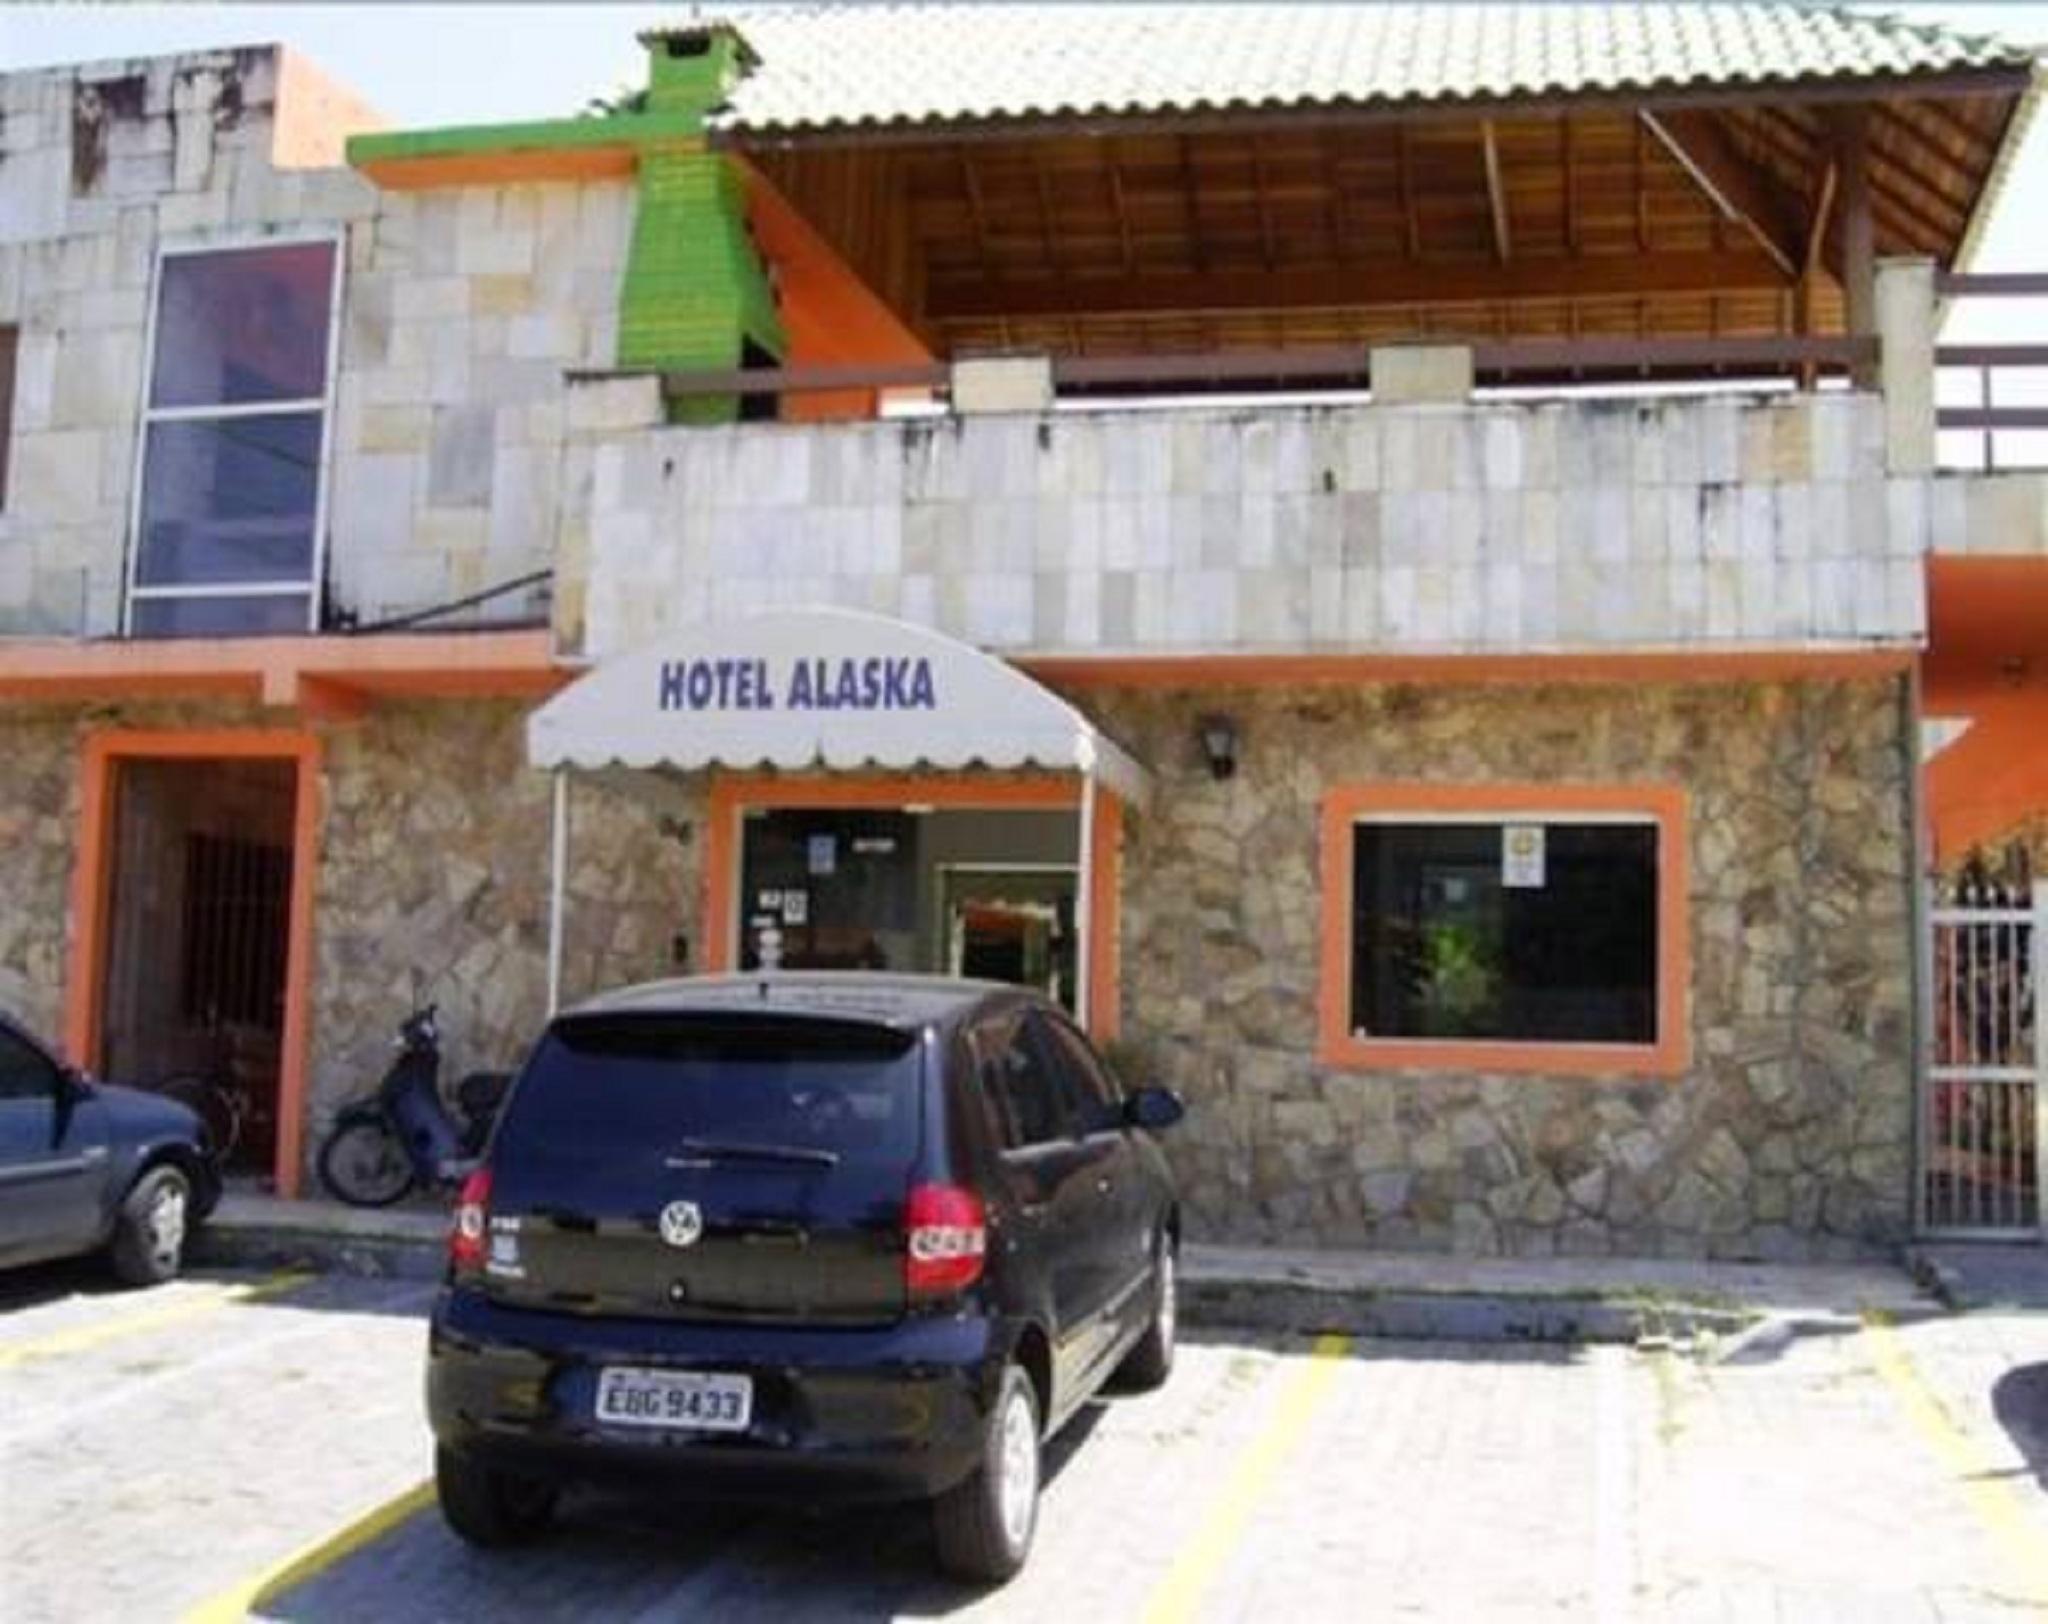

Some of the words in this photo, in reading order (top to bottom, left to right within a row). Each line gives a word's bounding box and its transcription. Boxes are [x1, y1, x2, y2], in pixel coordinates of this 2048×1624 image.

[659, 660, 774, 711] HOTEL
[787, 657, 935, 711] ALASKA
[666, 1389, 743, 1420] 9433
